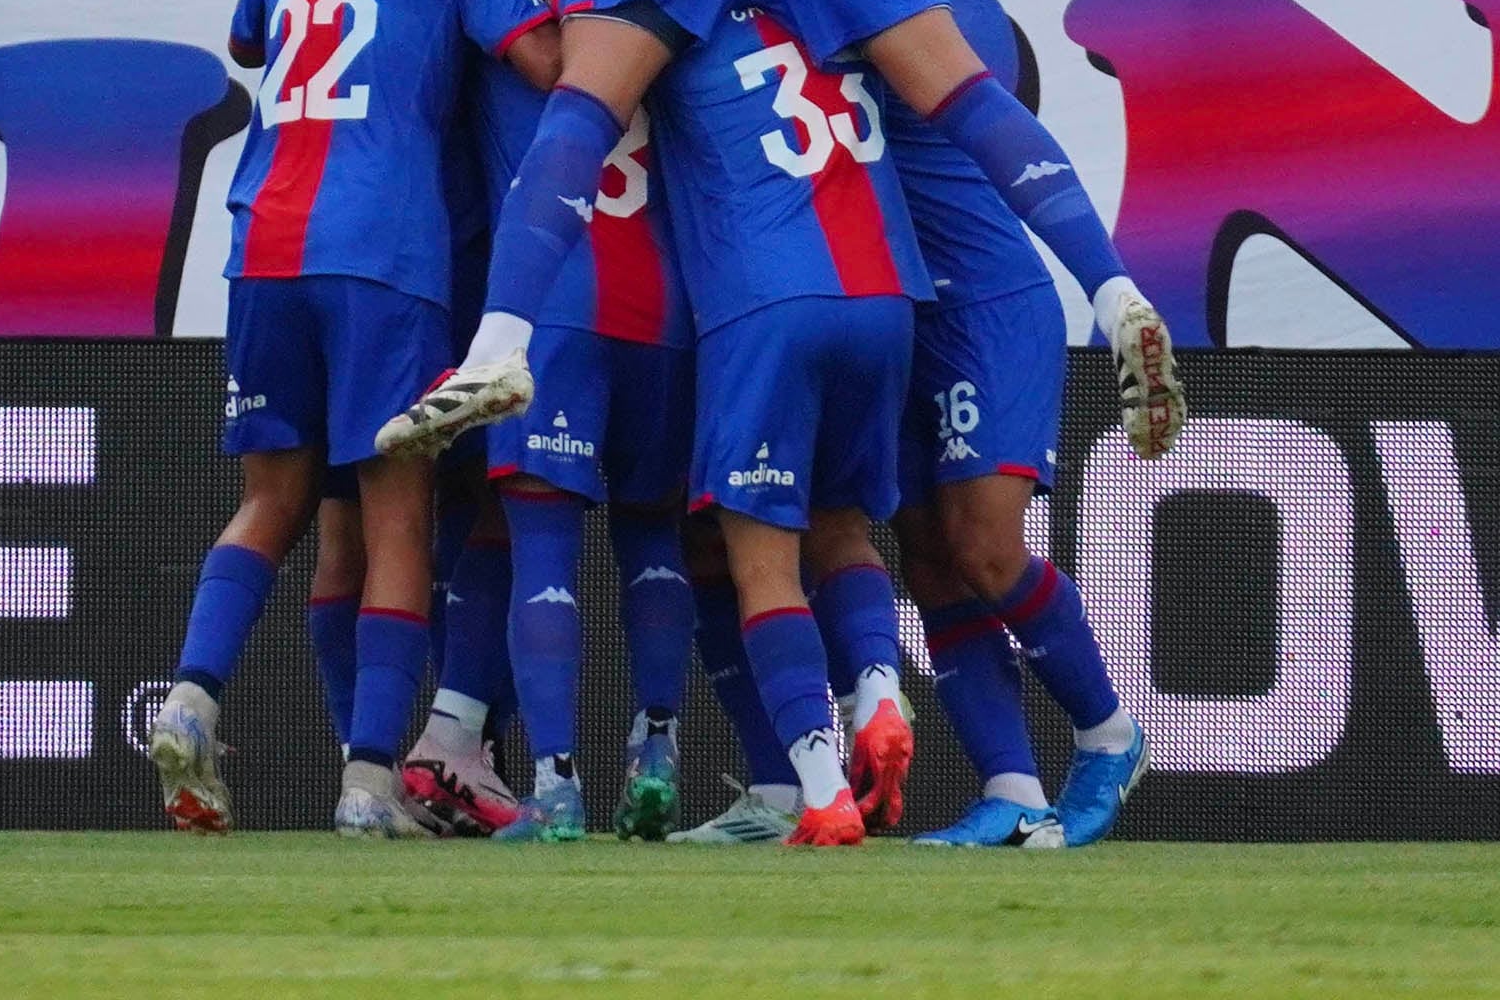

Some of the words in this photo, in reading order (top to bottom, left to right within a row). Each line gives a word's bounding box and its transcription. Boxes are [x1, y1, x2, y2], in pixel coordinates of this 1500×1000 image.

[934, 380, 980, 439] 16
[527, 431, 595, 457] andina
[728, 461, 796, 487] andina
